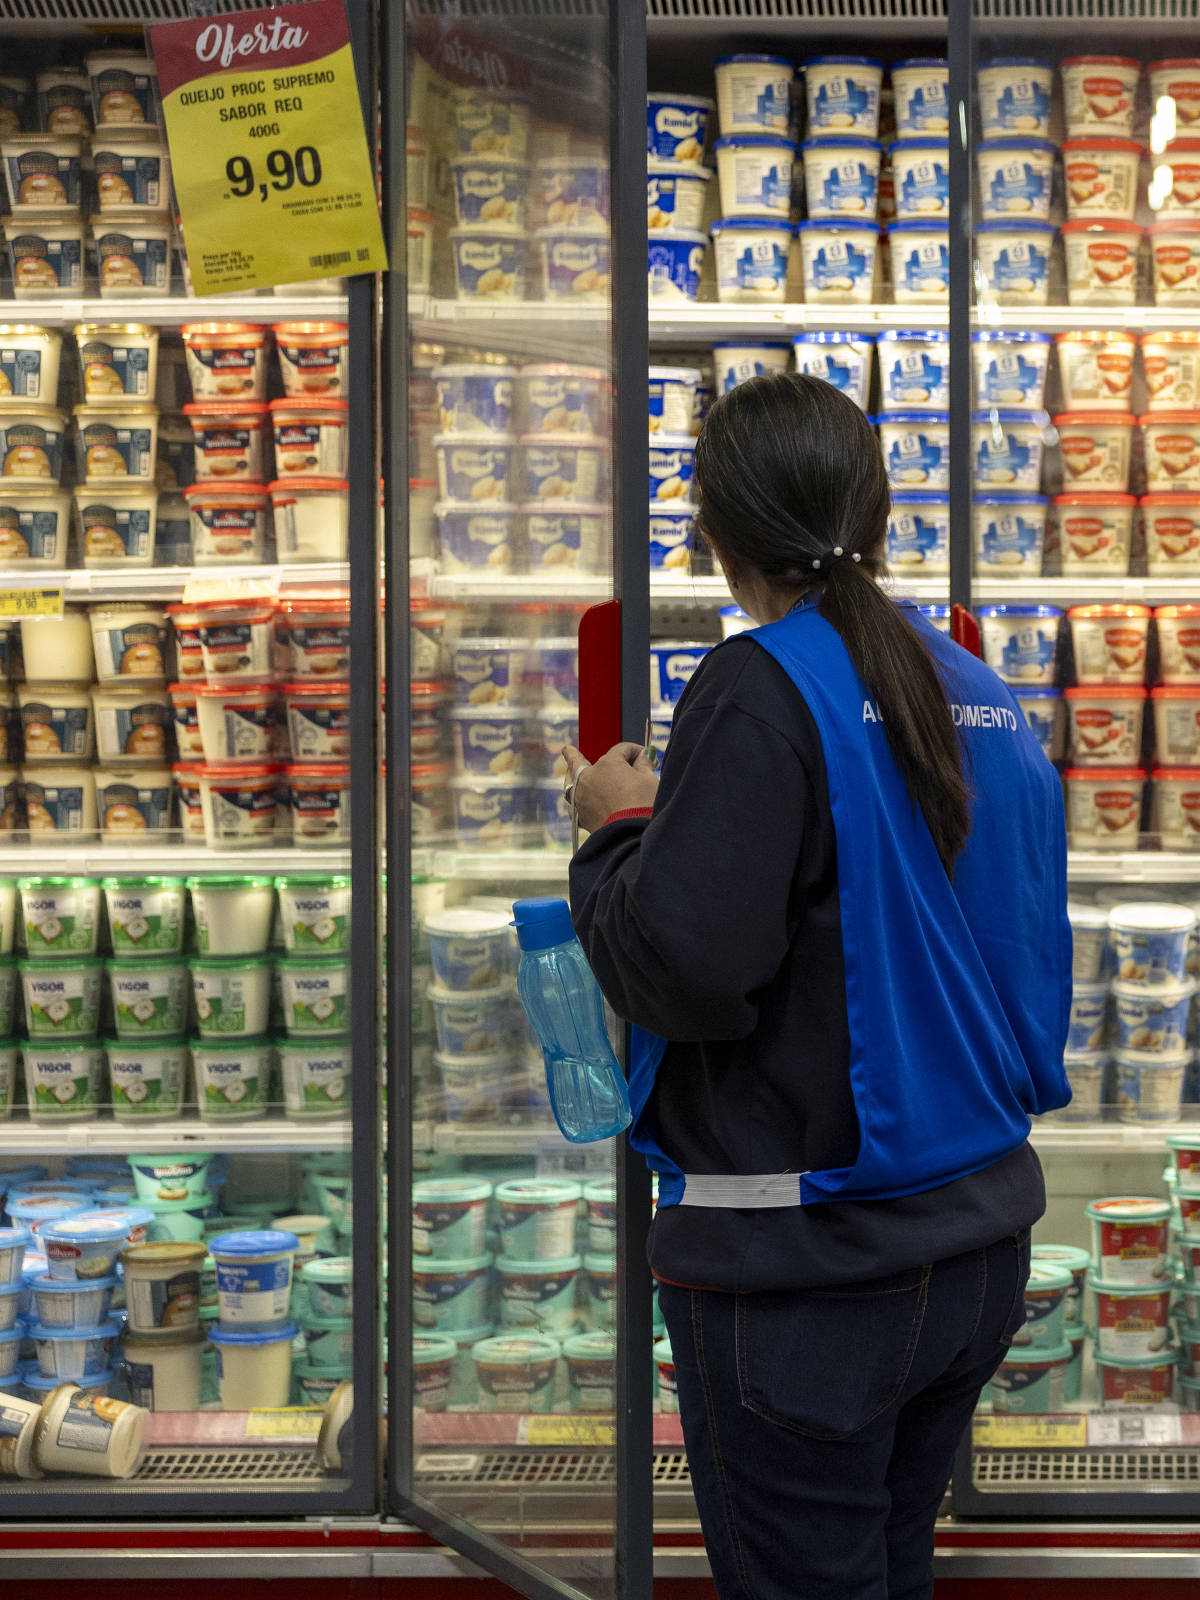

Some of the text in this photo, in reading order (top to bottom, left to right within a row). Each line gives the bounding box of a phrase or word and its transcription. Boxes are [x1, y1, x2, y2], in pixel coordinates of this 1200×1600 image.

[195, 16, 310, 68] Oferta
[180, 70, 335, 106] QUEIJO PROC SUPREMO
[219, 97, 303, 122] SABOR REQ
[248, 122, 280, 138] 400G
[225, 146, 323, 202] 9,90
[294, 900, 329, 911] VIGOR
[31, 981, 65, 993] VIGOR
[118, 980, 150, 992] VIGOR
[294, 979, 329, 991] VIGOR
[37, 1061, 73, 1074] VIGOR
[113, 1062, 143, 1075] VIGOR
[206, 1062, 242, 1075] VIGOR
[308, 1060, 344, 1073] VIGOR
